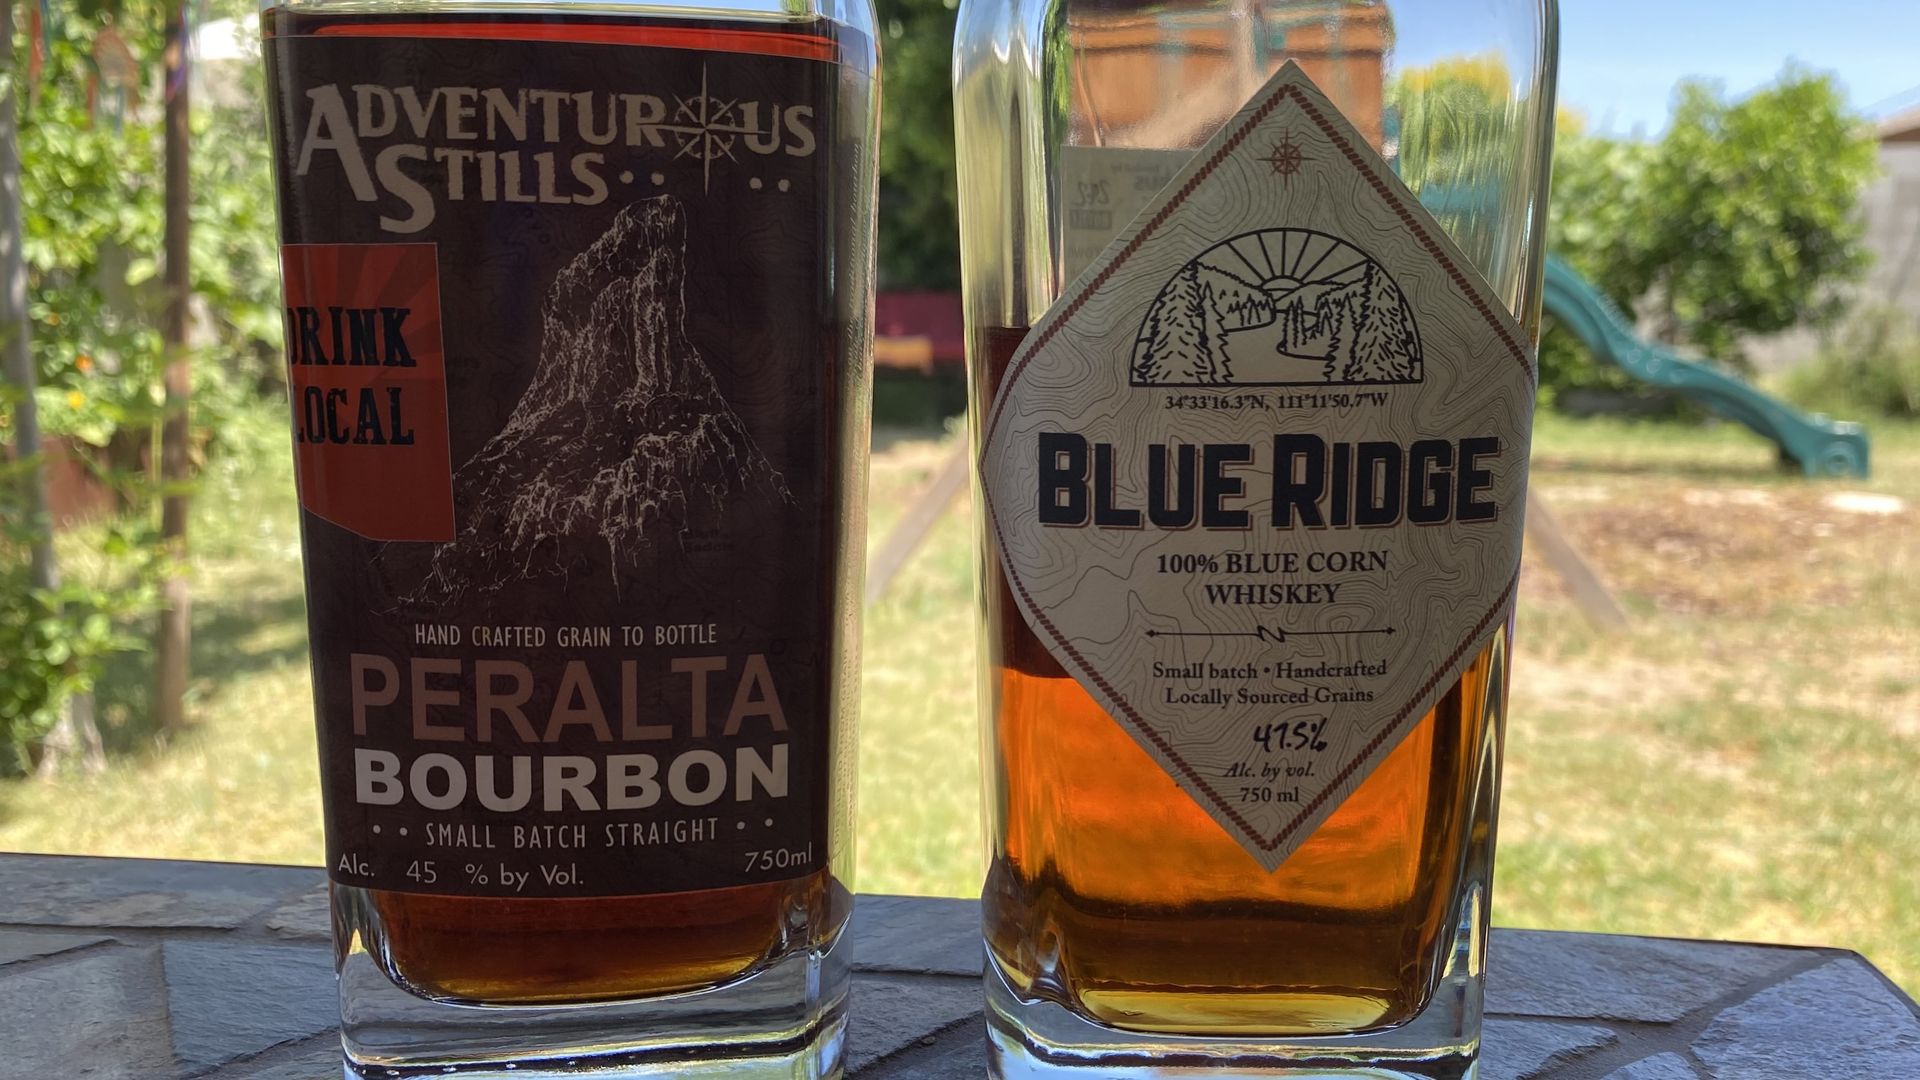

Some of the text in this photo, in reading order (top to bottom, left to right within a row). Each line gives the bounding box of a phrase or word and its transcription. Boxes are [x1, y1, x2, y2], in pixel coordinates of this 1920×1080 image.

[376, 144, 610, 234] STILLS
[1038, 431, 1501, 531] BLUE RIDGE
[1157, 550, 1388, 575] 100% BLUE CORN
[1204, 583, 1342, 606] WHISKEY
[415, 623, 717, 648] HAND CRAFTED GRAIN TO BOTTLE
[1152, 659, 1387, 679] Small batch Handcrafted
[350, 653, 789, 743] PERALTA
[1166, 687, 1375, 709] Locally Sourced Grains
[354, 743, 789, 812] BOURBON
[1223, 761, 1315, 782] Alc. by vol.
[1240, 787, 1299, 803] 750 ml
[426, 817, 719, 849] SMALL BATCH STRAIGHT
[743, 842, 812, 874] 750ml
[338, 853, 584, 892] Alc. 45 % by Vol.
